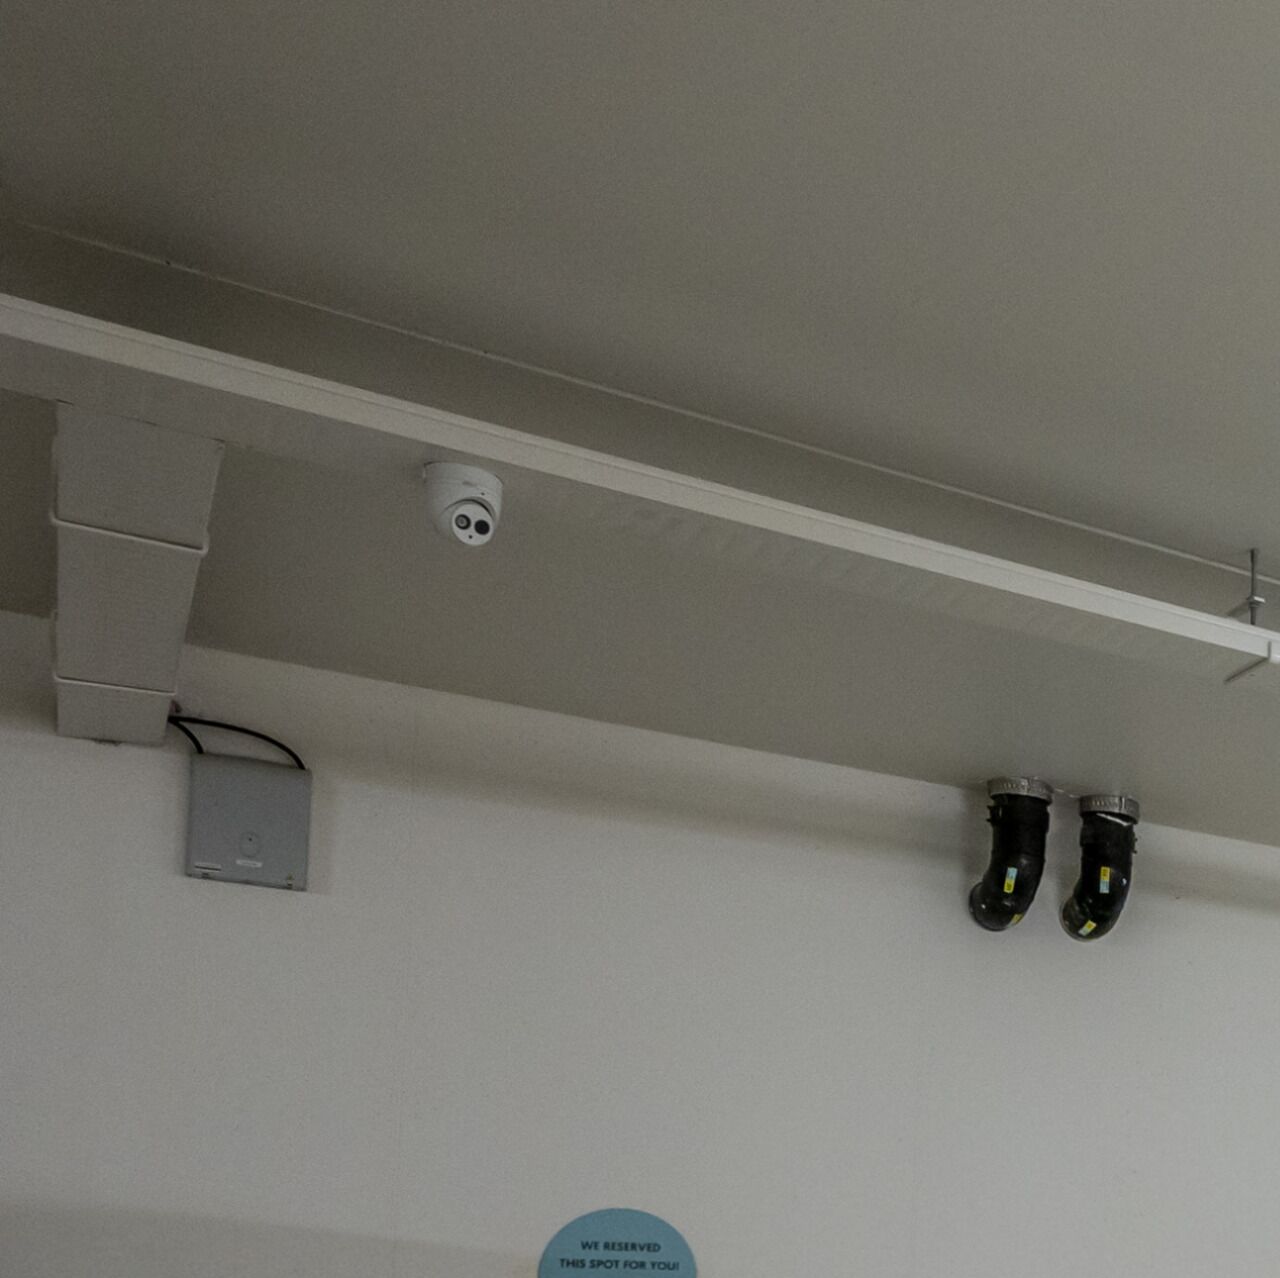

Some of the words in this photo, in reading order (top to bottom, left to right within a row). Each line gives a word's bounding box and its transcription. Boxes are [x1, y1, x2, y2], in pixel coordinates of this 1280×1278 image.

[581, 1241, 599, 1250] WE
[603, 1242, 661, 1252] RESERVED
[560, 1258, 586, 1269] THIS
[588, 1259, 619, 1270] SPOT
[623, 1261, 646, 1270] FOR
[651, 1262, 680, 1271] YOU!
